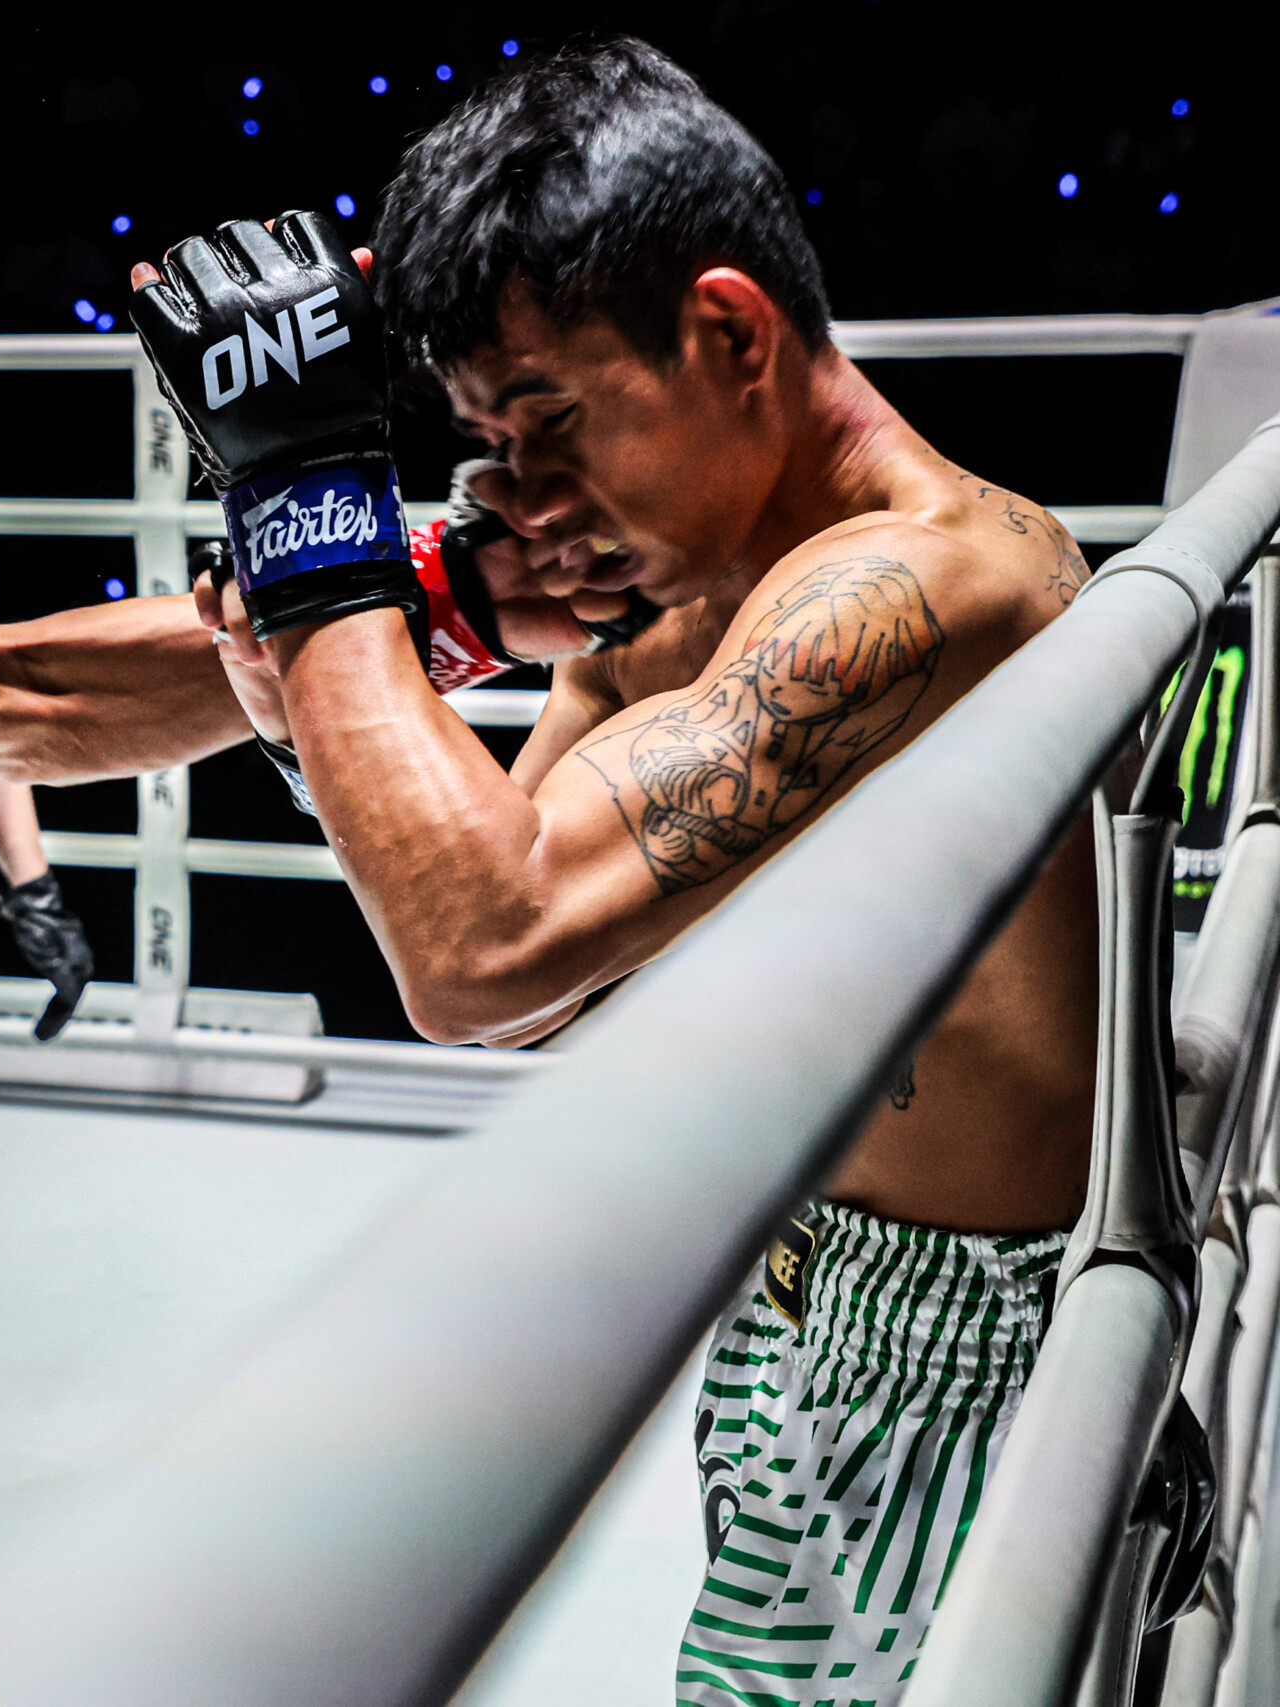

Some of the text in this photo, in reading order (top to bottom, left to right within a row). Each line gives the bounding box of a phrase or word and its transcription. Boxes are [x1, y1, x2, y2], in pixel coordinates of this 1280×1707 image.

[202, 286, 350, 410] ONE
[150, 407, 173, 475] ONE
[242, 486, 378, 574] Fairtex
[149, 905, 173, 975] ONE
